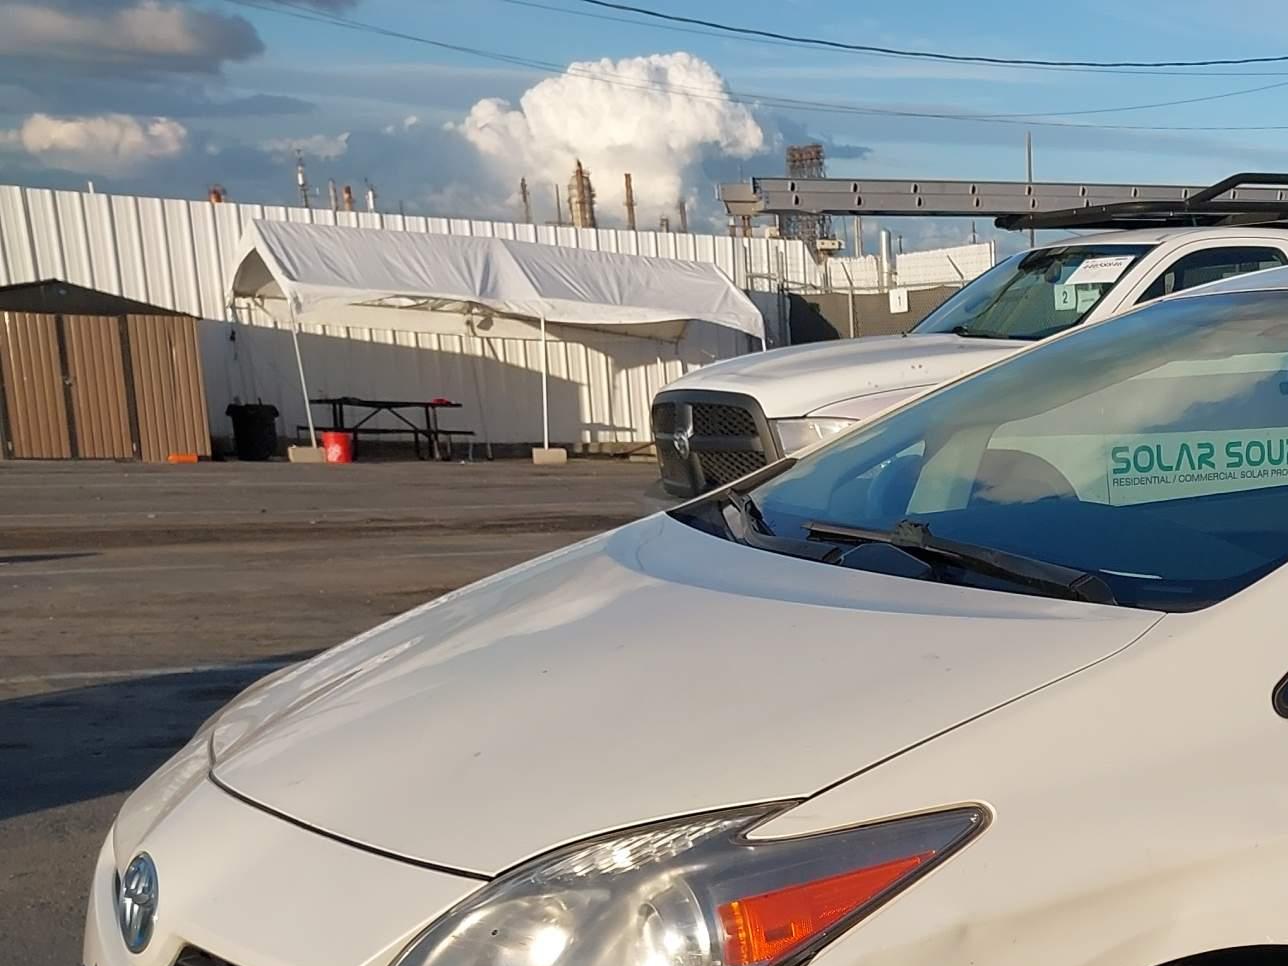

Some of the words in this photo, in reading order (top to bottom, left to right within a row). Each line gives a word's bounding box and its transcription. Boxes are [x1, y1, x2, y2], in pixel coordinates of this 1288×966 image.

[1062, 291, 1068, 304] 2
[1112, 442, 1216, 475] SOLAR
[1113, 475, 1172, 487] RESIDENTIAL
[1178, 471, 1237, 483] COMMERCIAL
[1240, 469, 1269, 479] SOLAR
